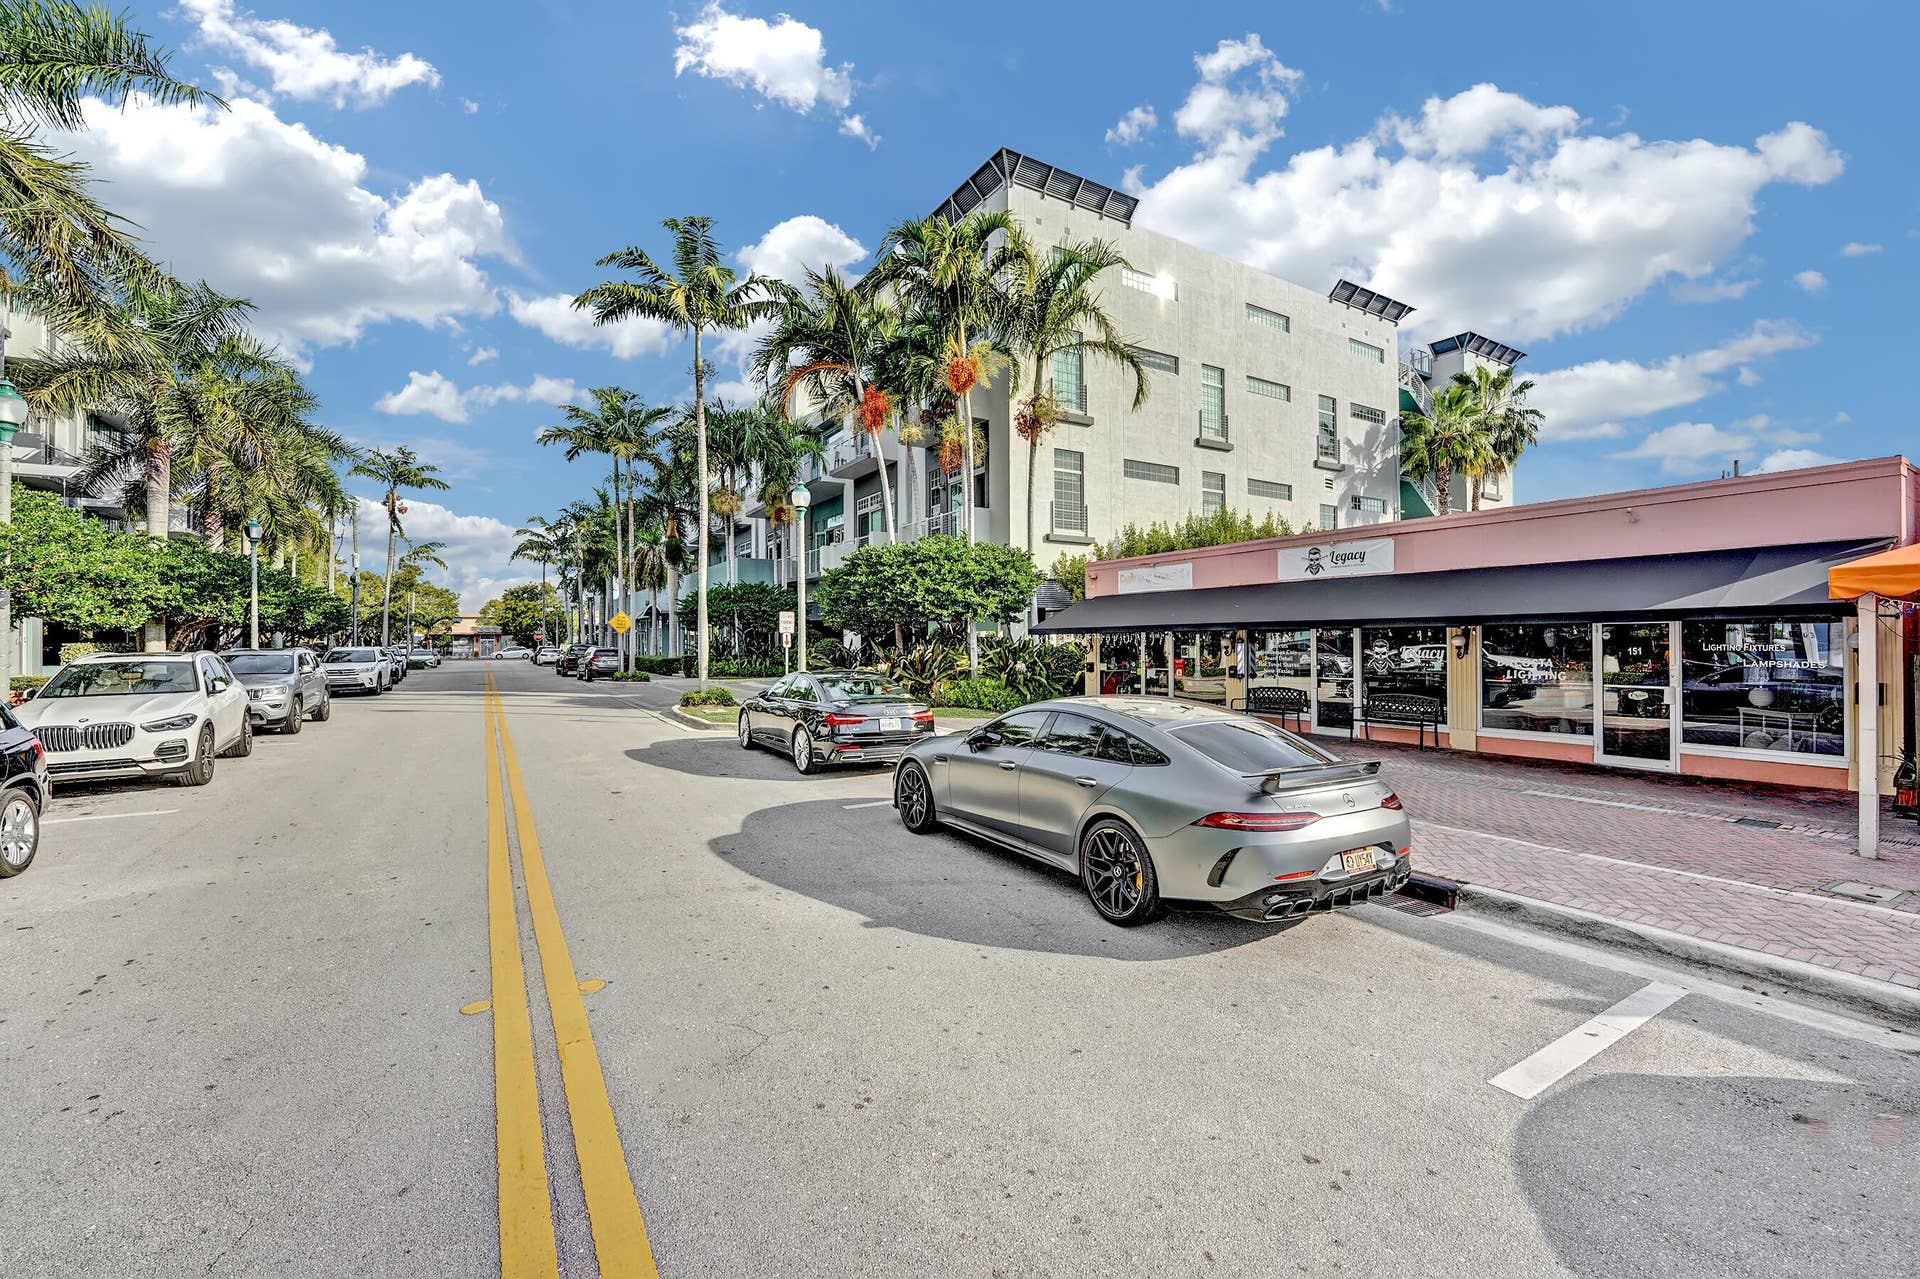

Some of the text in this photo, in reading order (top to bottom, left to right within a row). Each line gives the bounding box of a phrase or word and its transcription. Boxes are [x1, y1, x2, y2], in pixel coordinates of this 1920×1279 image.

[1329, 550, 1366, 565] Legacy
[1627, 646, 1642, 656] 151
[1702, 642, 1786, 652] LIGHTING FIXTURES
[1496, 658, 1554, 668] DCOSTA
[1743, 658, 1826, 669] LAMPSHADES
